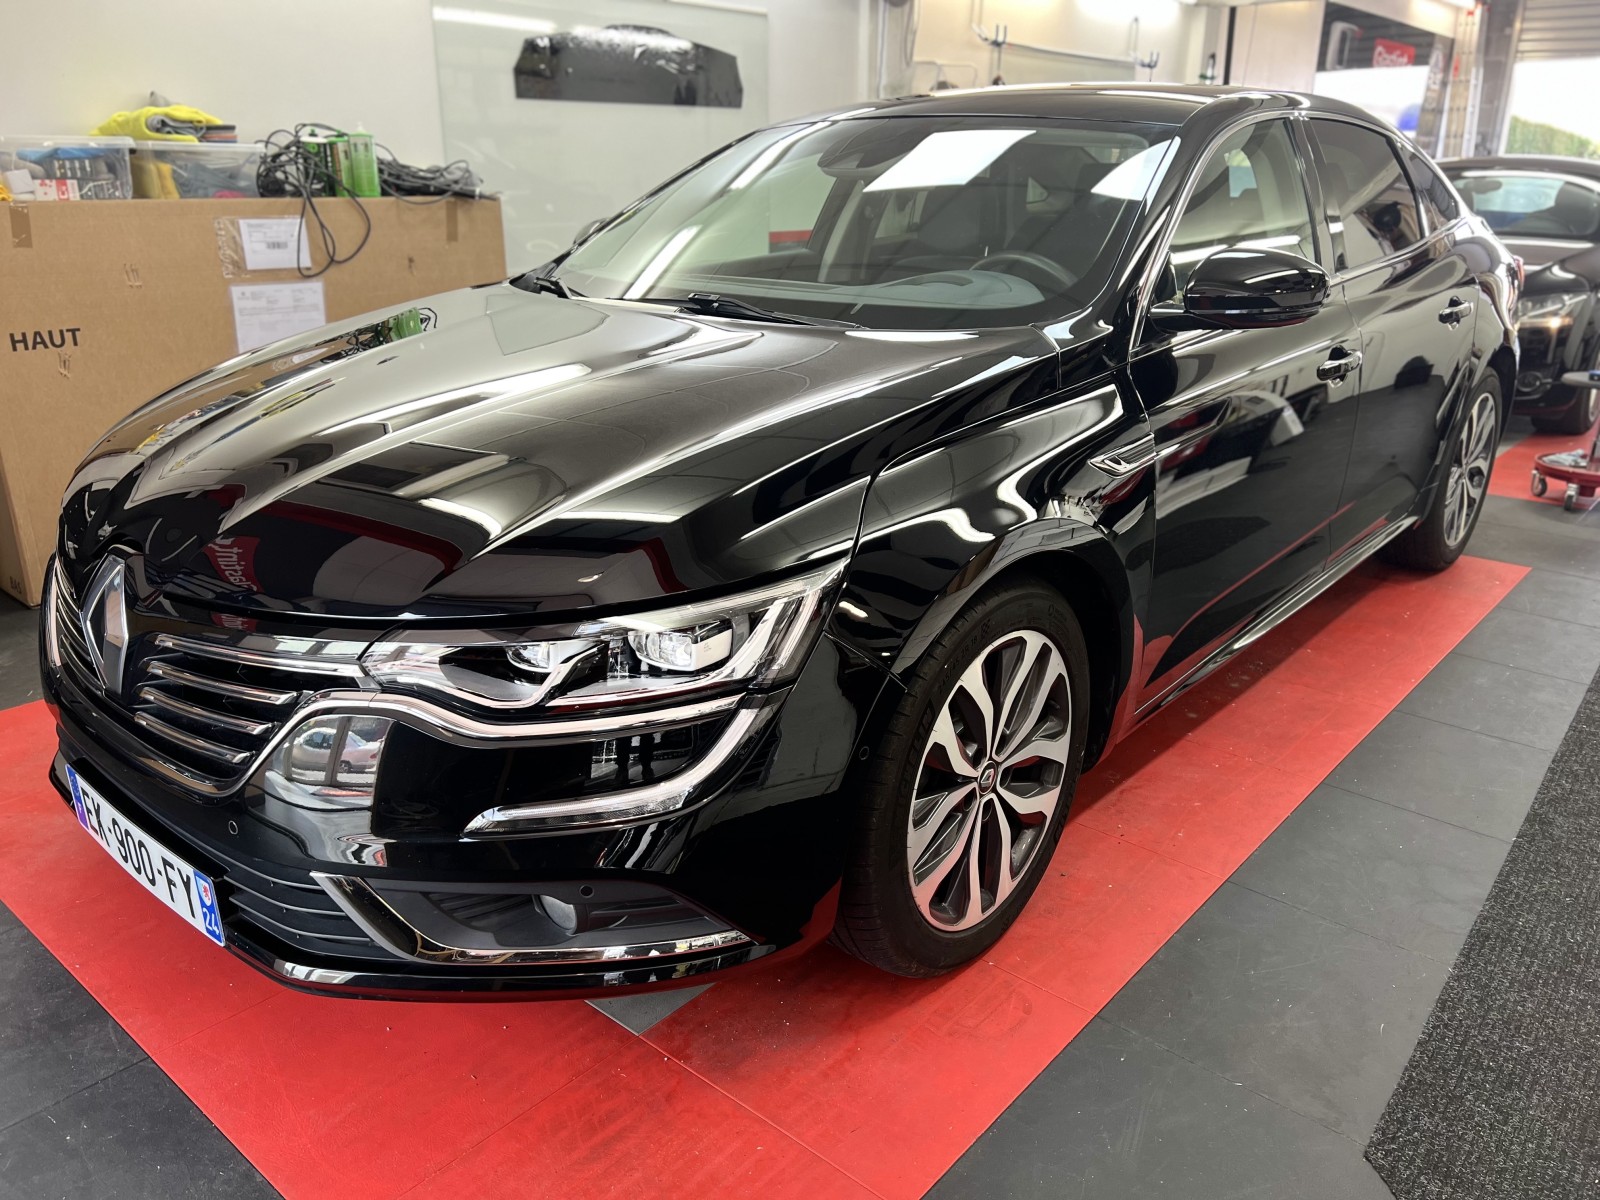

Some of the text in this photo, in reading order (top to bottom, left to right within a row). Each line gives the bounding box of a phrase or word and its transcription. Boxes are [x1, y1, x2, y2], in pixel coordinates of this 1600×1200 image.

[9, 328, 81, 352] HAUT
[80, 786, 196, 919] EK-900-FY
[202, 907, 220, 936] 24
